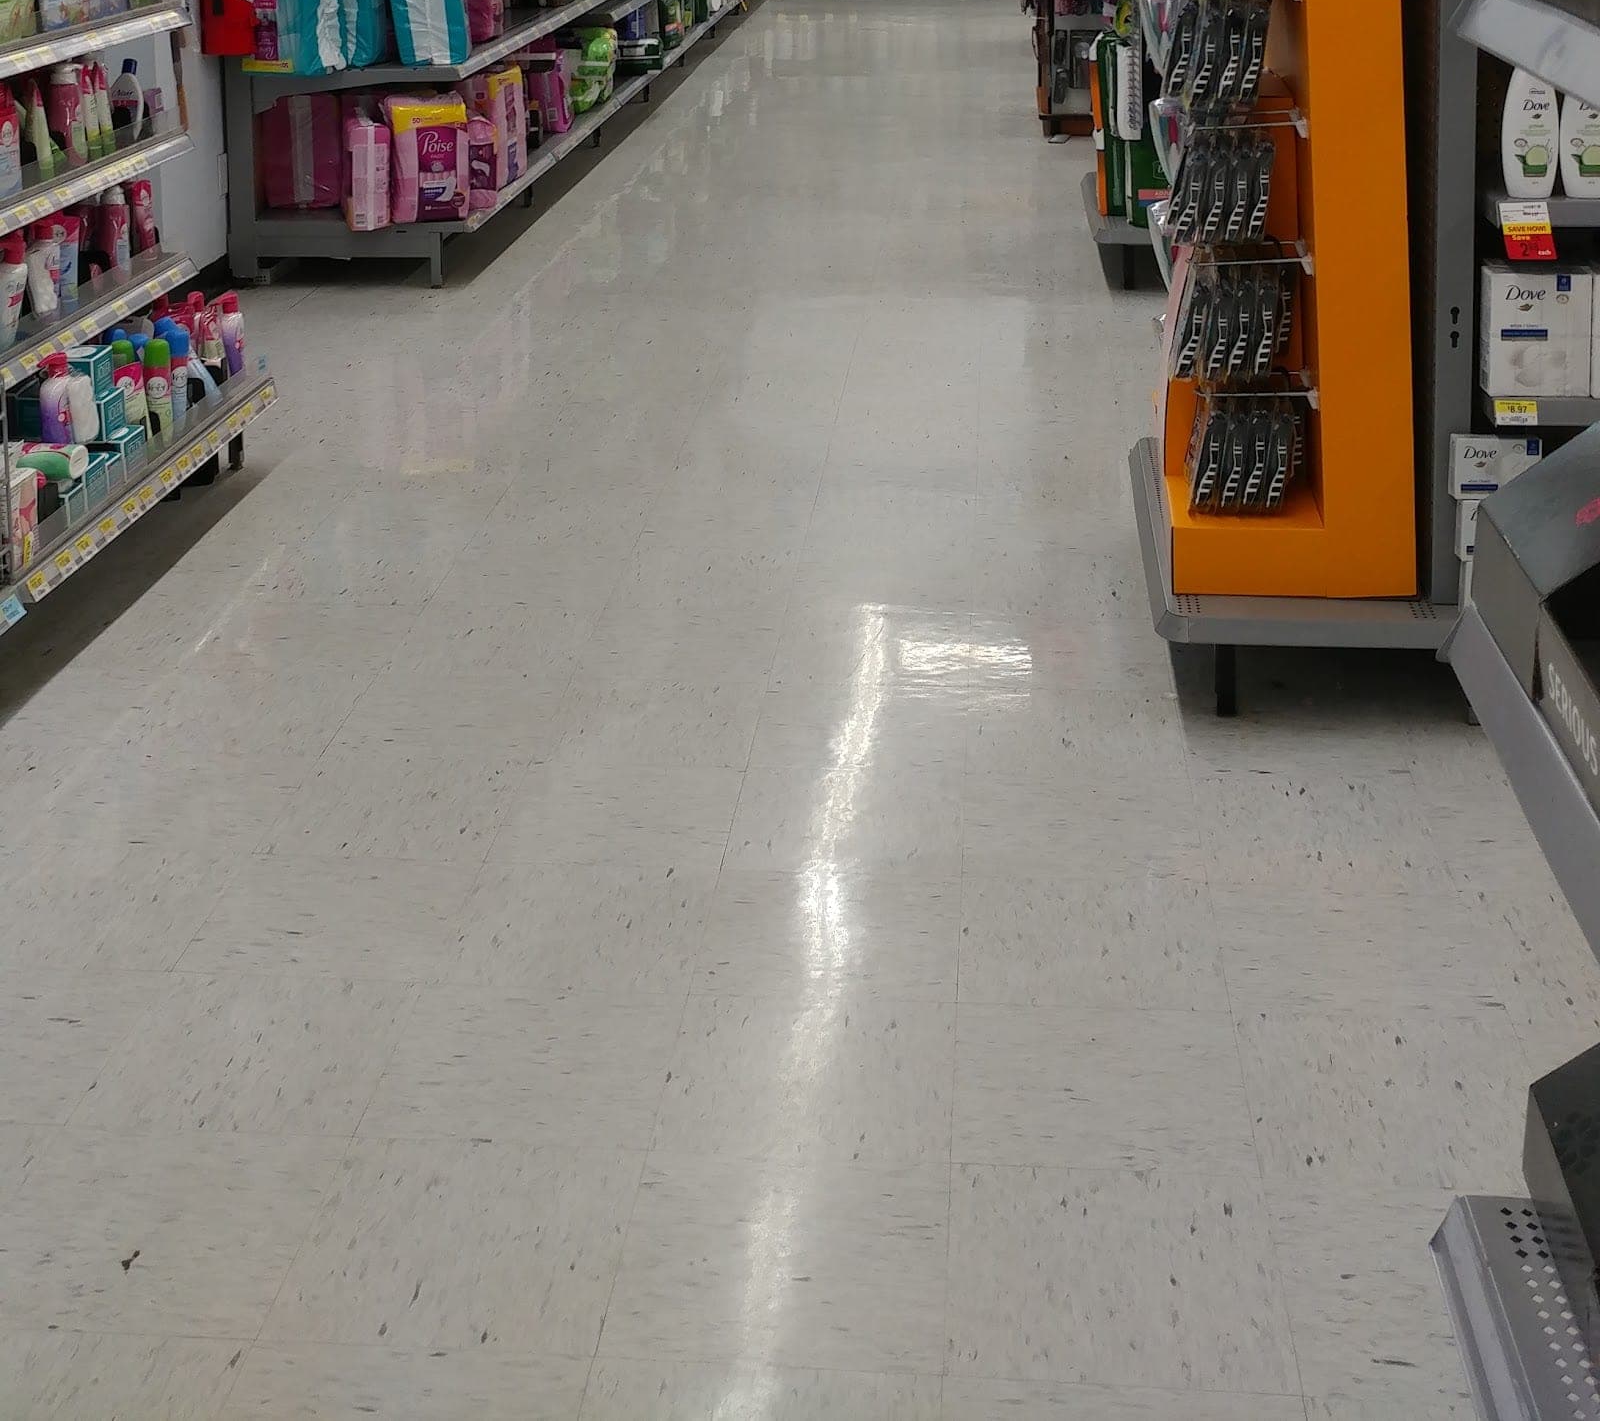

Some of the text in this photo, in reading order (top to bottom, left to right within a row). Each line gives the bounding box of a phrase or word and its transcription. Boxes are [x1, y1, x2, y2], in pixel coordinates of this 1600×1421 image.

[1523, 99, 1550, 111] Dove
[418, 130, 454, 156] Poise
[1504, 284, 1546, 300] Dove
[1463, 445, 1497, 459] Dove
[1548, 662, 1599, 776] SERIOUS
